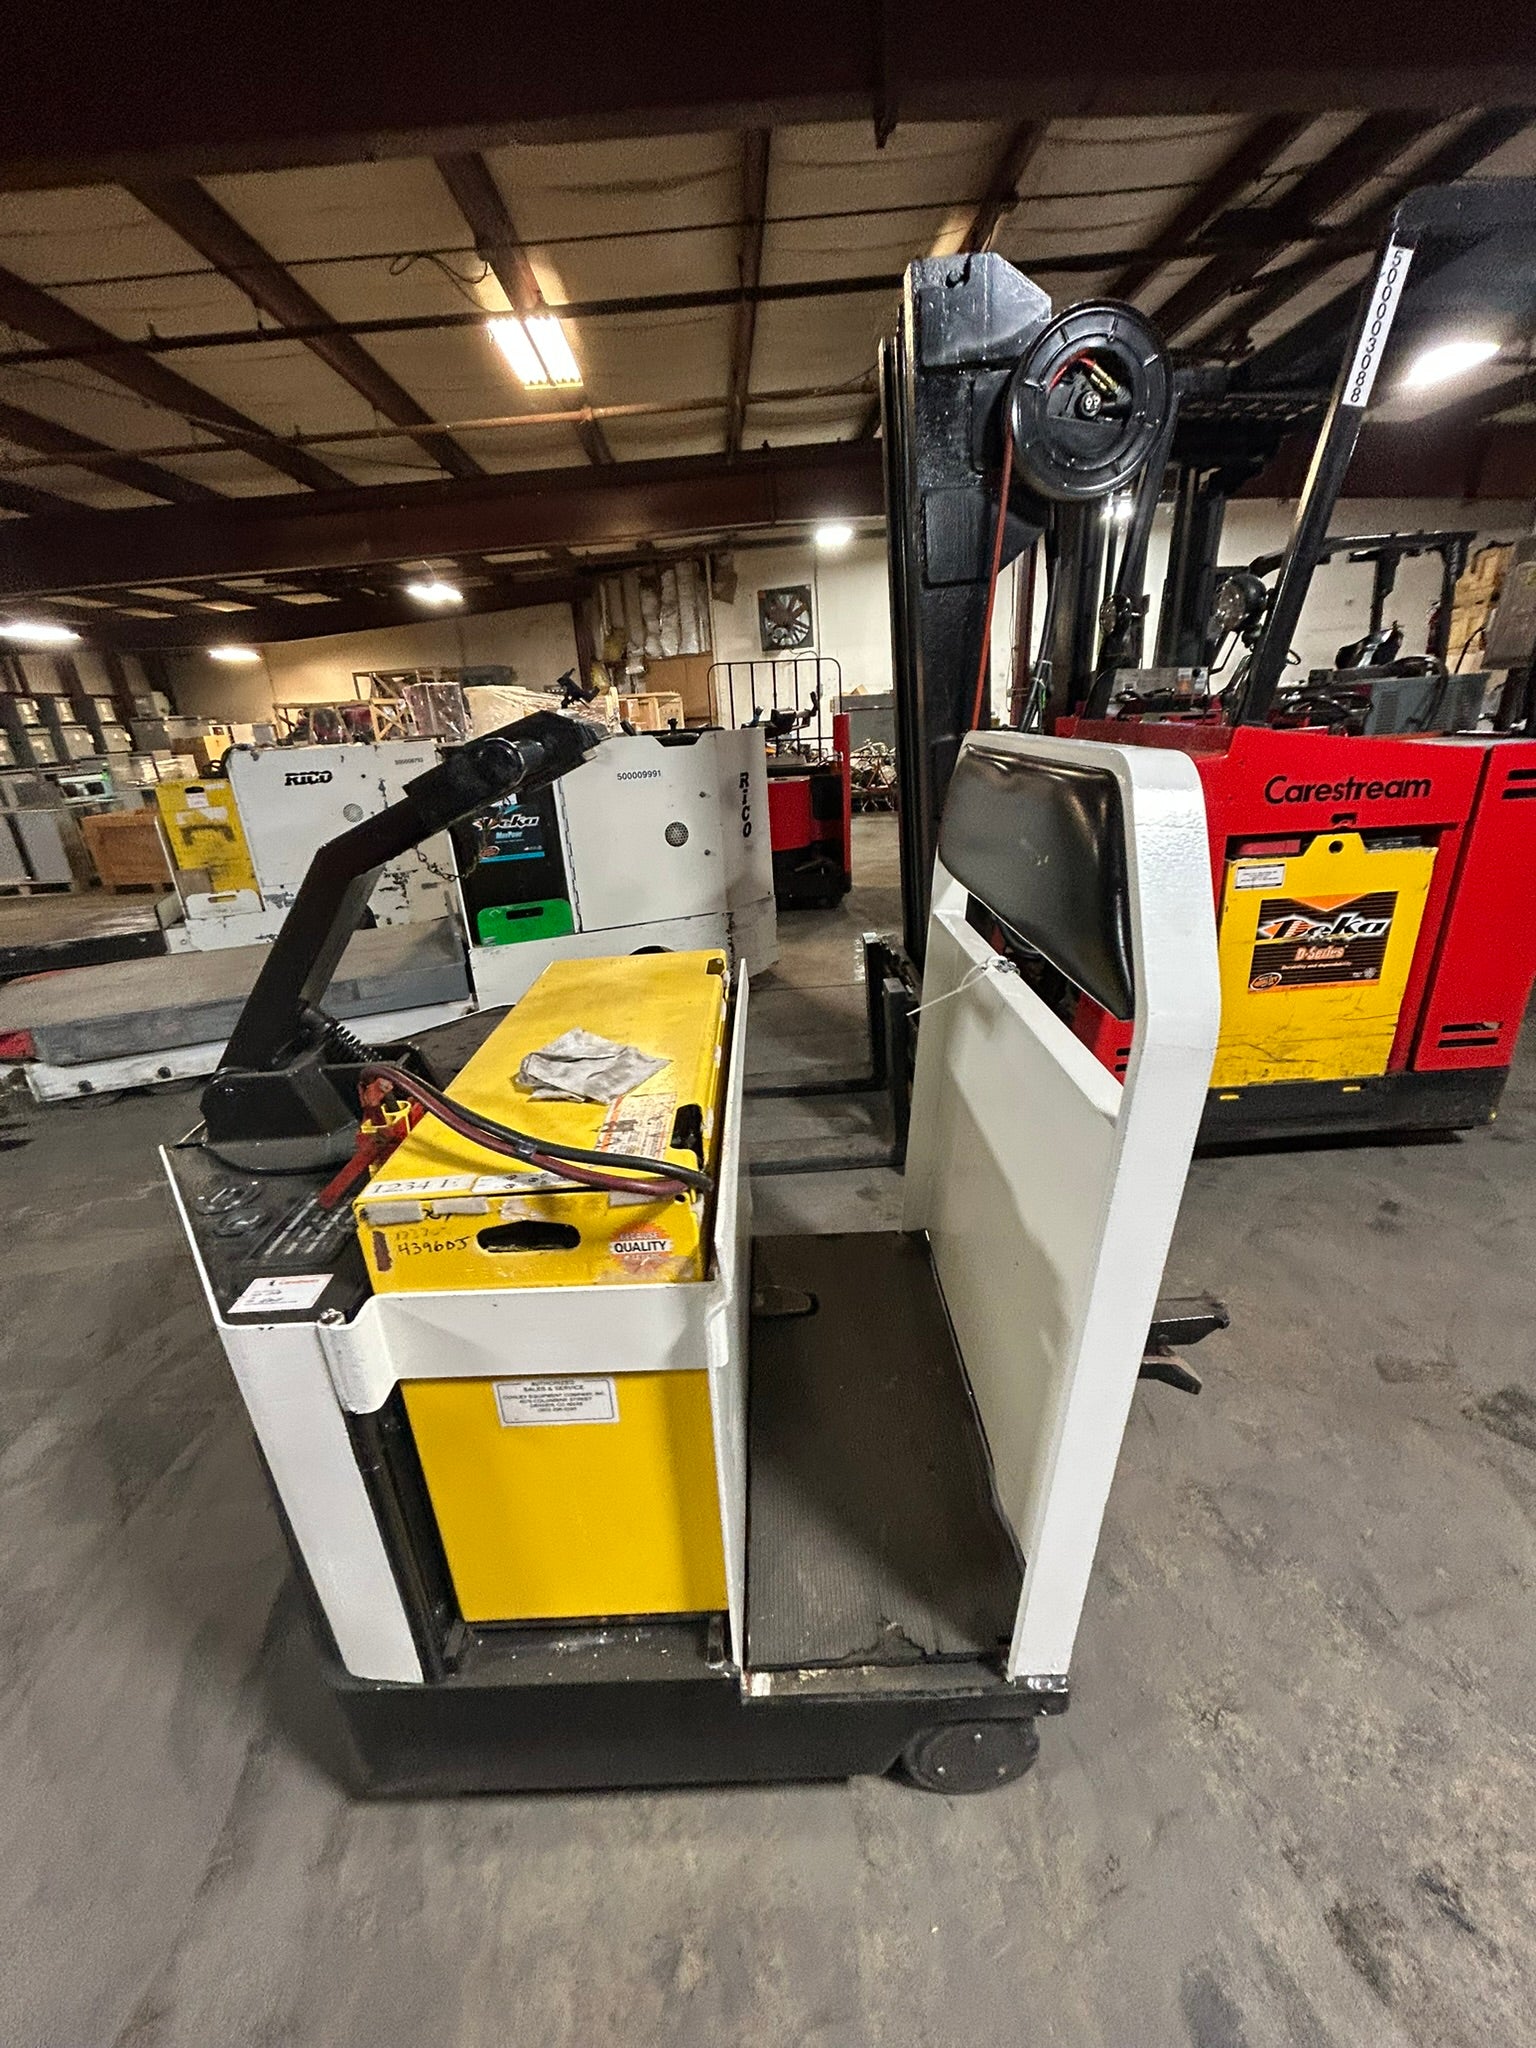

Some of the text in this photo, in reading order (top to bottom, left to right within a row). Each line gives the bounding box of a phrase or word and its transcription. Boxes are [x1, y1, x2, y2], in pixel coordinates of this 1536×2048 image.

[1350, 250, 1403, 403] 500003088
[617, 769, 662, 781] 500009991
[1264, 775, 1432, 804] Carestream
[1257, 912, 1394, 941] Deka
[614, 1240, 667, 1253] QUALITY
